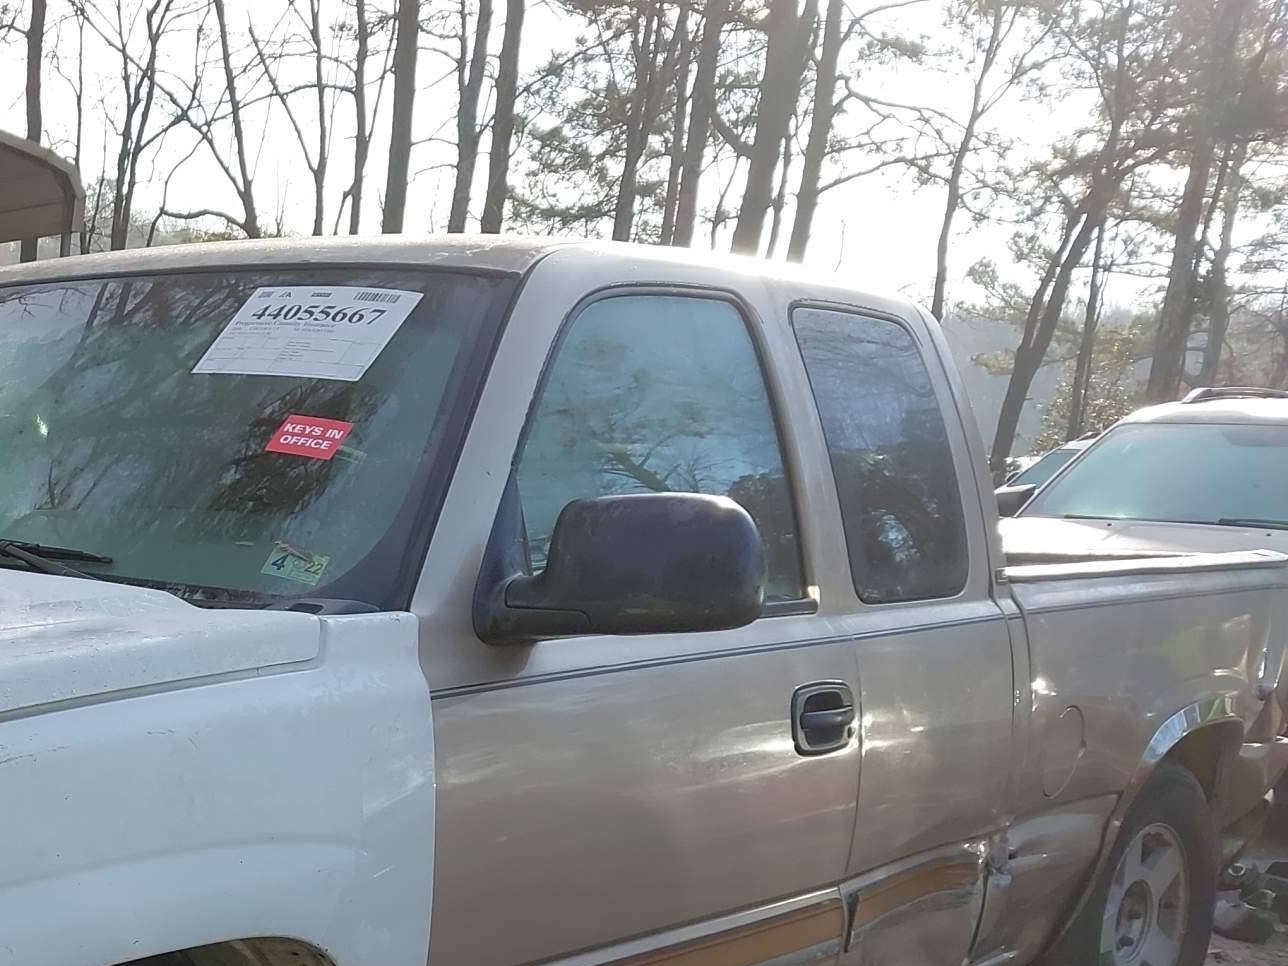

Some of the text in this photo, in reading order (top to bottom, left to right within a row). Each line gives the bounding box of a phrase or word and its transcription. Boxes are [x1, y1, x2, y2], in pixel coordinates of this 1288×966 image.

[251, 304, 387, 326] 44055667
[283, 423, 344, 440] KEYS IN
[279, 436, 333, 450] OFFICE
[271, 554, 324, 575] 4 22
